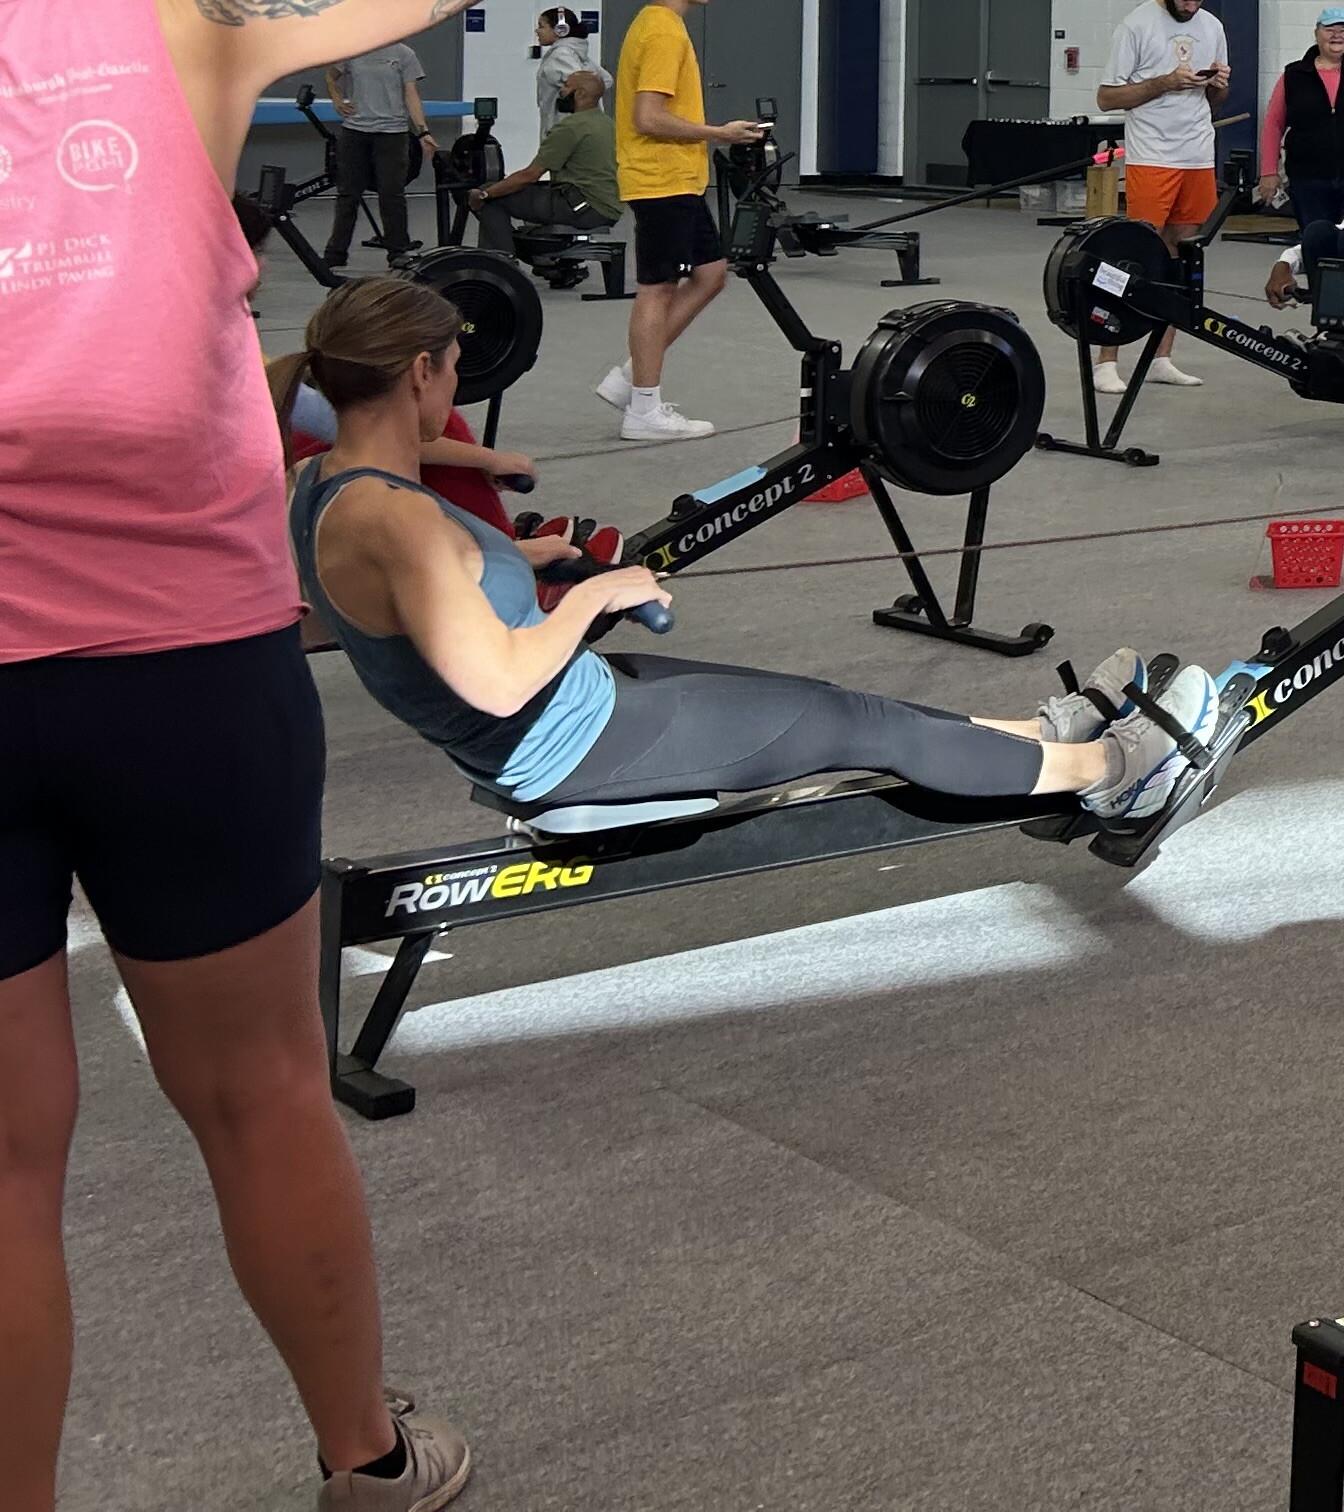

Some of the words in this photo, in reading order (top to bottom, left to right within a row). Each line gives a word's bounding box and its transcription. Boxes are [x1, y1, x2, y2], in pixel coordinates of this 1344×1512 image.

[1225, 328, 1295, 370] concept
[1292, 357, 1302, 371] 2
[677, 475, 796, 553] concept
[797, 463, 816, 484] 2
